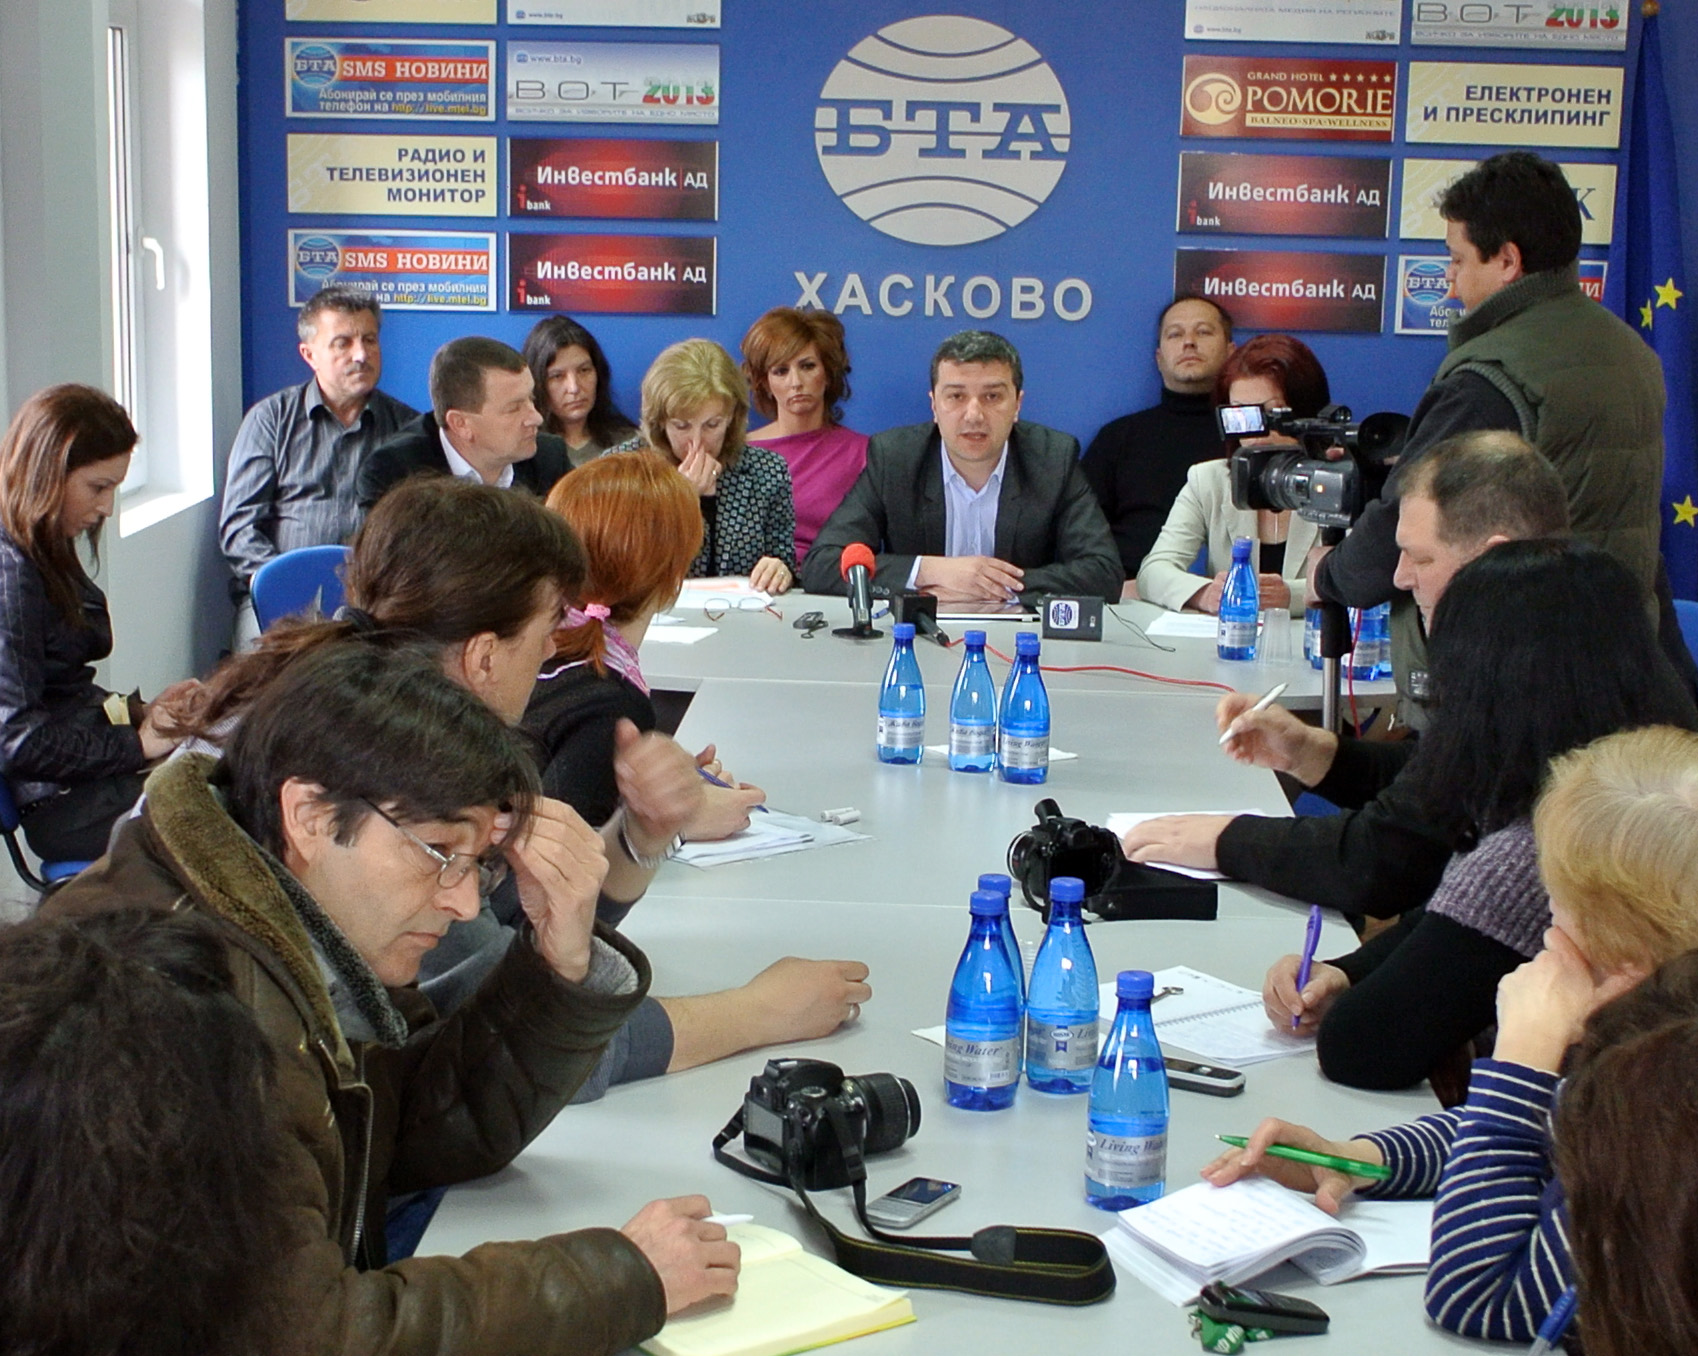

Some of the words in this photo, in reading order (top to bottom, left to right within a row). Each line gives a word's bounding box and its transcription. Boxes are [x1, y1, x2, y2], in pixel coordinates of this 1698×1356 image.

[1546, 2, 1620, 29] 2013
[295, 59, 337, 72] БТА
[342, 61, 386, 77] SMS
[395, 62, 487, 80] НОВИНИ
[1247, 72, 1287, 81] GRAND
[1291, 72, 1324, 82] HOTEL
[319, 88, 377, 102] Абонирай
[379, 91, 394, 101] се
[396, 91, 424, 103] през
[427, 90, 487, 102] мобилния
[642, 77, 715, 105] 2013
[1246, 86, 1392, 114] POMORIE
[1465, 85, 1611, 104] ЕЛЕКТРОНЕН
[319, 101, 372, 114] телефон
[374, 103, 389, 111] на
[1423, 106, 1438, 121] И
[1446, 107, 1611, 126] ПРЕСКЛИПИНГ
[820, 98, 1067, 161] БТА
[398, 148, 466, 164] РАДИО
[473, 150, 485, 163] И
[326, 167, 486, 183] ТЕЛЕВИЗИОНЕН
[537, 166, 677, 187] Инвестбанк
[683, 171, 708, 189] АД
[387, 188, 486, 203] МОНИТОР
[1208, 182, 1349, 204] Инвестбанк
[1356, 189, 1380, 207] АД
[298, 250, 338, 263] БТА
[345, 252, 387, 268] SMS
[397, 253, 488, 271] НОВИНИ
[537, 261, 676, 281] Инвестбанк
[683, 267, 707, 283] АД
[381, 282, 395, 291] се
[397, 282, 425, 294] през
[428, 282, 487, 294] мобилния
[793, 271, 1092, 321] ХАСКОВО
[1204, 277, 1345, 298] Инвестбанк
[1351, 284, 1376, 300] АД
[376, 294, 390, 303] на
[965, 1044, 1000, 1056] Water
[1100, 1139, 1140, 1154] Living
